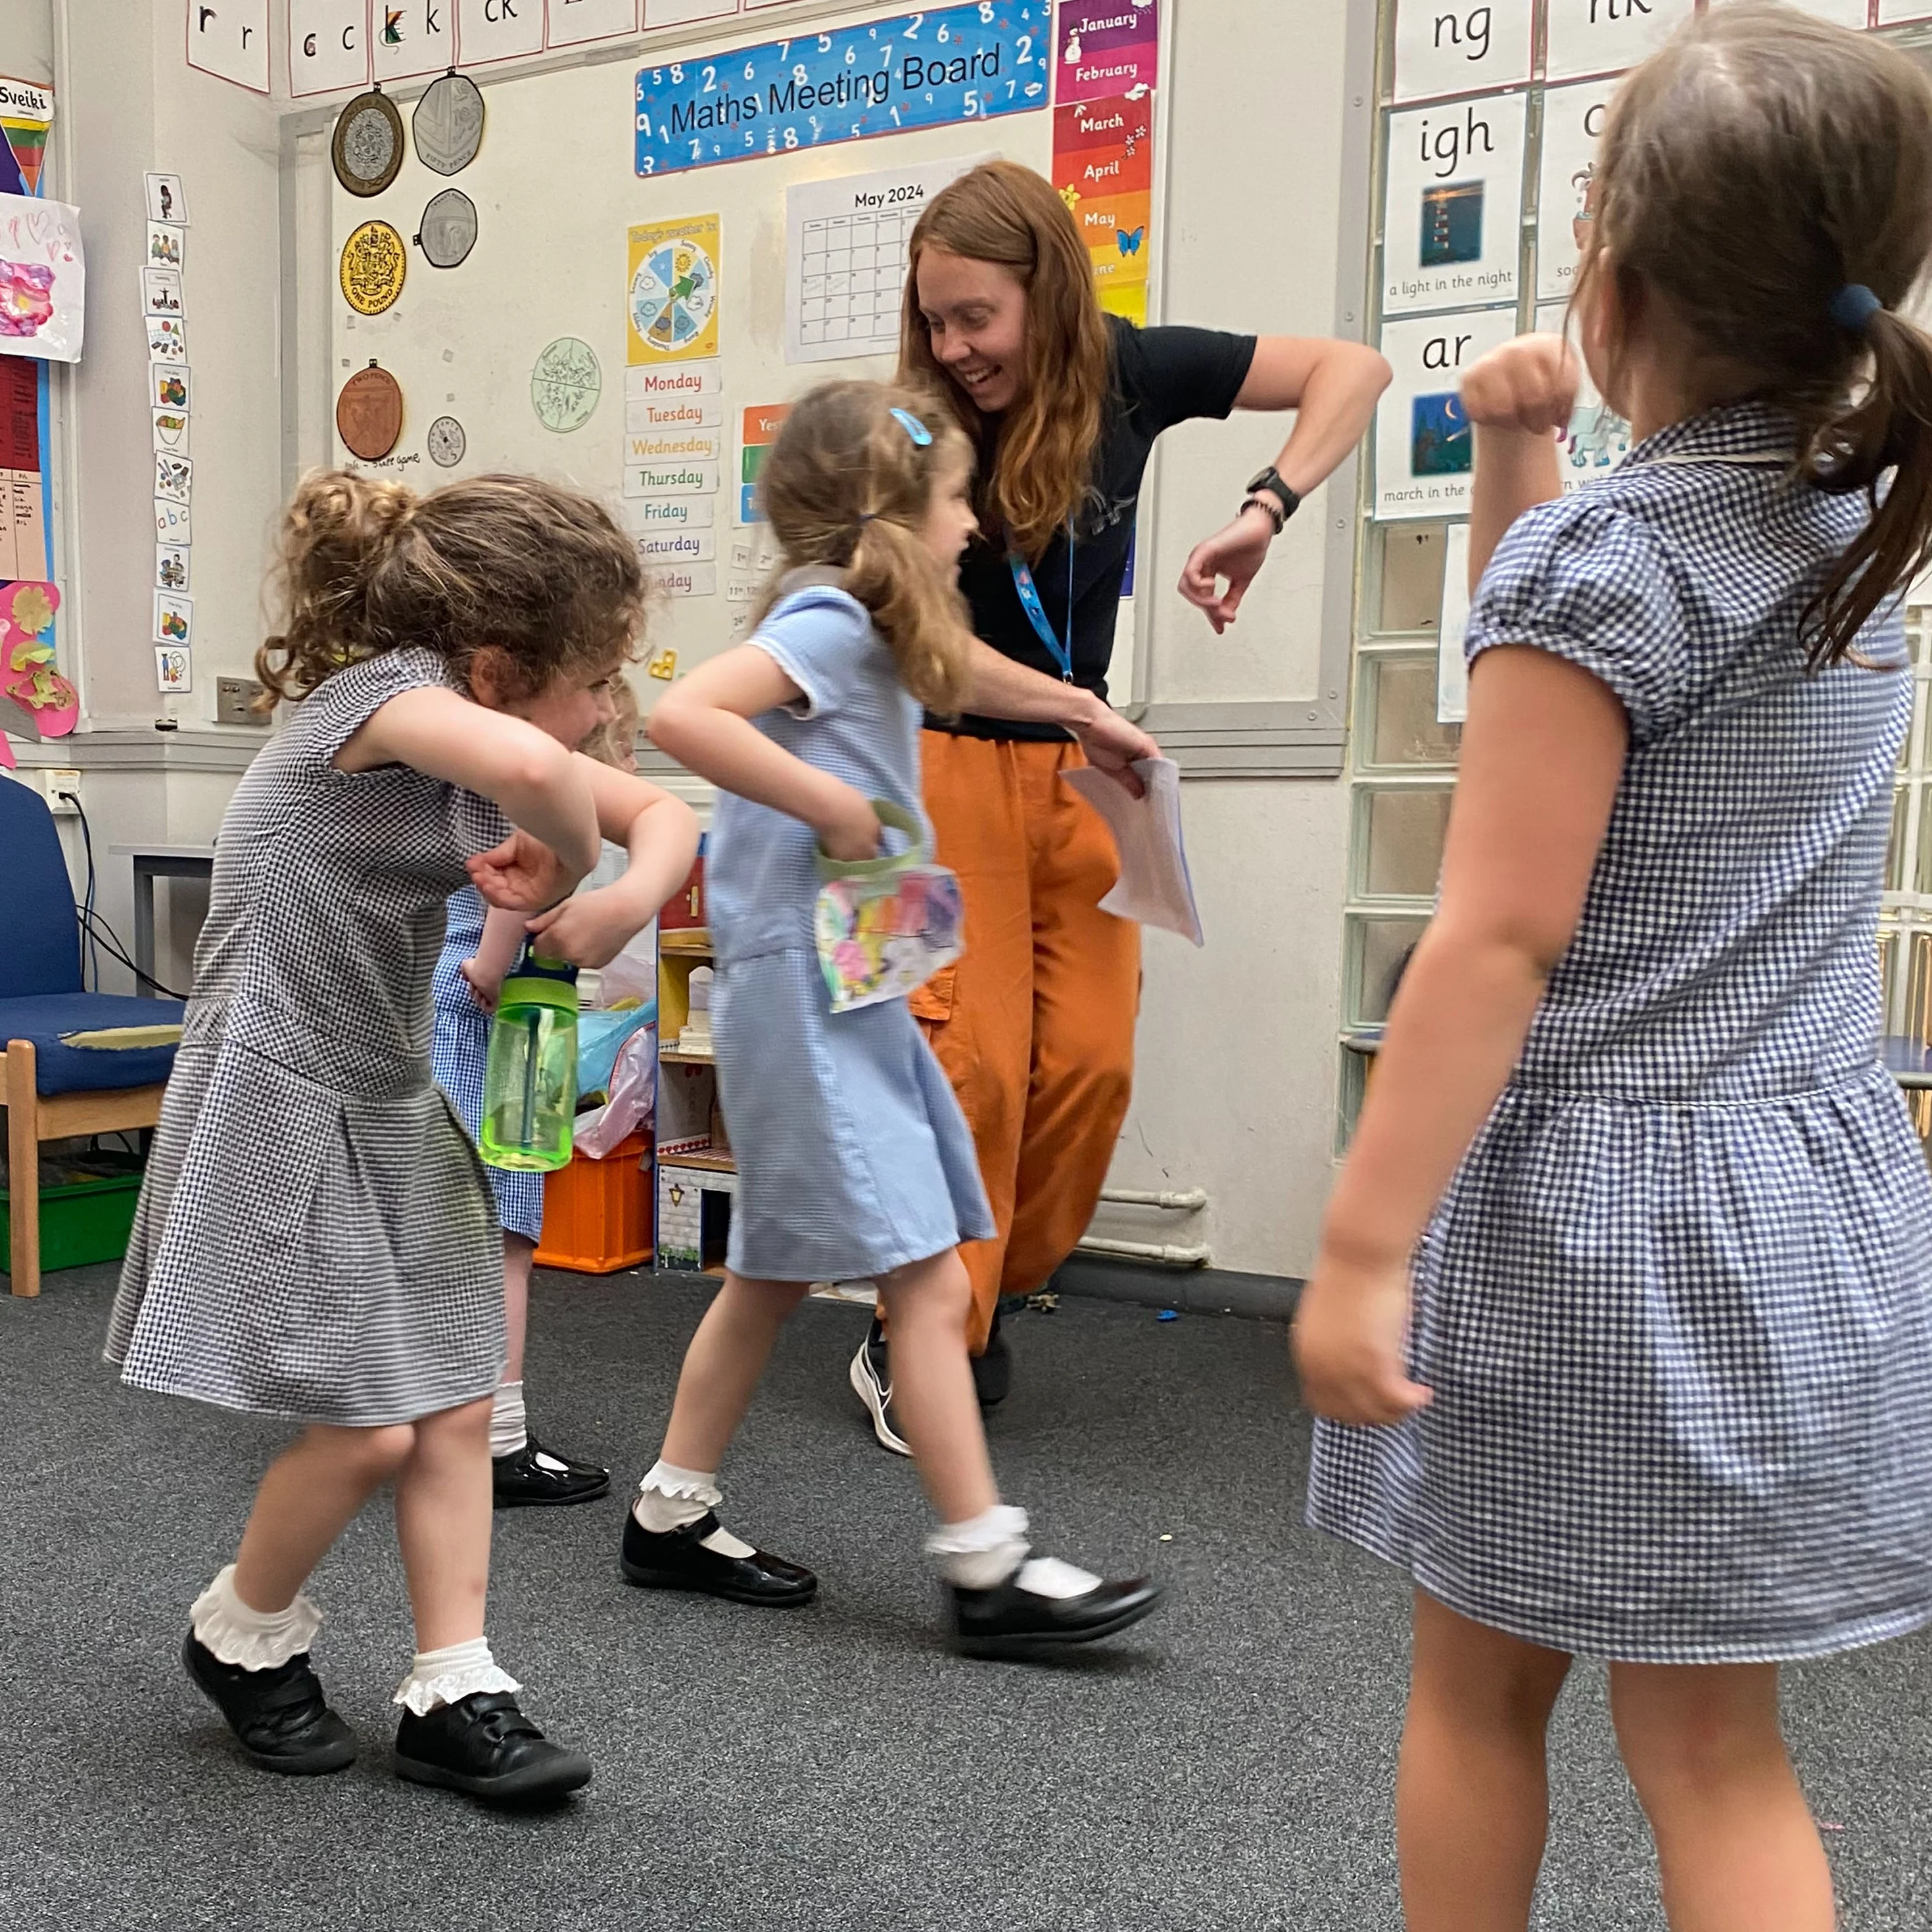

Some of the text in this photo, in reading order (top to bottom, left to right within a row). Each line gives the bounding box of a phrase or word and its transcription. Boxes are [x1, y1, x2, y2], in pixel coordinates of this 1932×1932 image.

[978, 1, 995, 24] 8
[199, 6, 252, 49] r r
[903, 13, 924, 40] 2
[937, 24, 950, 43] 6
[1079, 14, 1137, 34] January
[1434, 7, 1491, 60] ng
[778, 41, 789, 62] 7
[818, 34, 832, 53] 5
[1016, 35, 1033, 64] 2
[845, 45, 856, 64] 6
[879, 45, 893, 68] 7
[653, 70, 662, 85] 5
[670, 64, 684, 84] 8
[702, 66, 717, 93] 2
[744, 62, 754, 80] 6
[1076, 62, 1138, 82] February
[0, 87, 47, 109] Sveiki
[672, 43, 1000, 134] Maths Meeting Board
[963, 90, 978, 116] 5
[1080, 114, 1124, 133] March
[783, 127, 799, 149] 8
[1421, 107, 1494, 177] igh
[1084, 161, 1119, 181] April
[855, 184, 924, 208] May 2024
[1085, 213, 1116, 229] May
[1390, 268, 1512, 298] a light in the night
[351, 287, 392, 308] ONE POUND
[1423, 334, 1472, 369] ar
[644, 373, 702, 392] Monday
[647, 404, 703, 425] Tuesday
[632, 437, 712, 456] Wednesday
[640, 469, 703, 488] Thursday
[1384, 484, 1465, 502] march in the
[645, 503, 688, 523] Friday
[638, 536, 700, 555] Saturday
